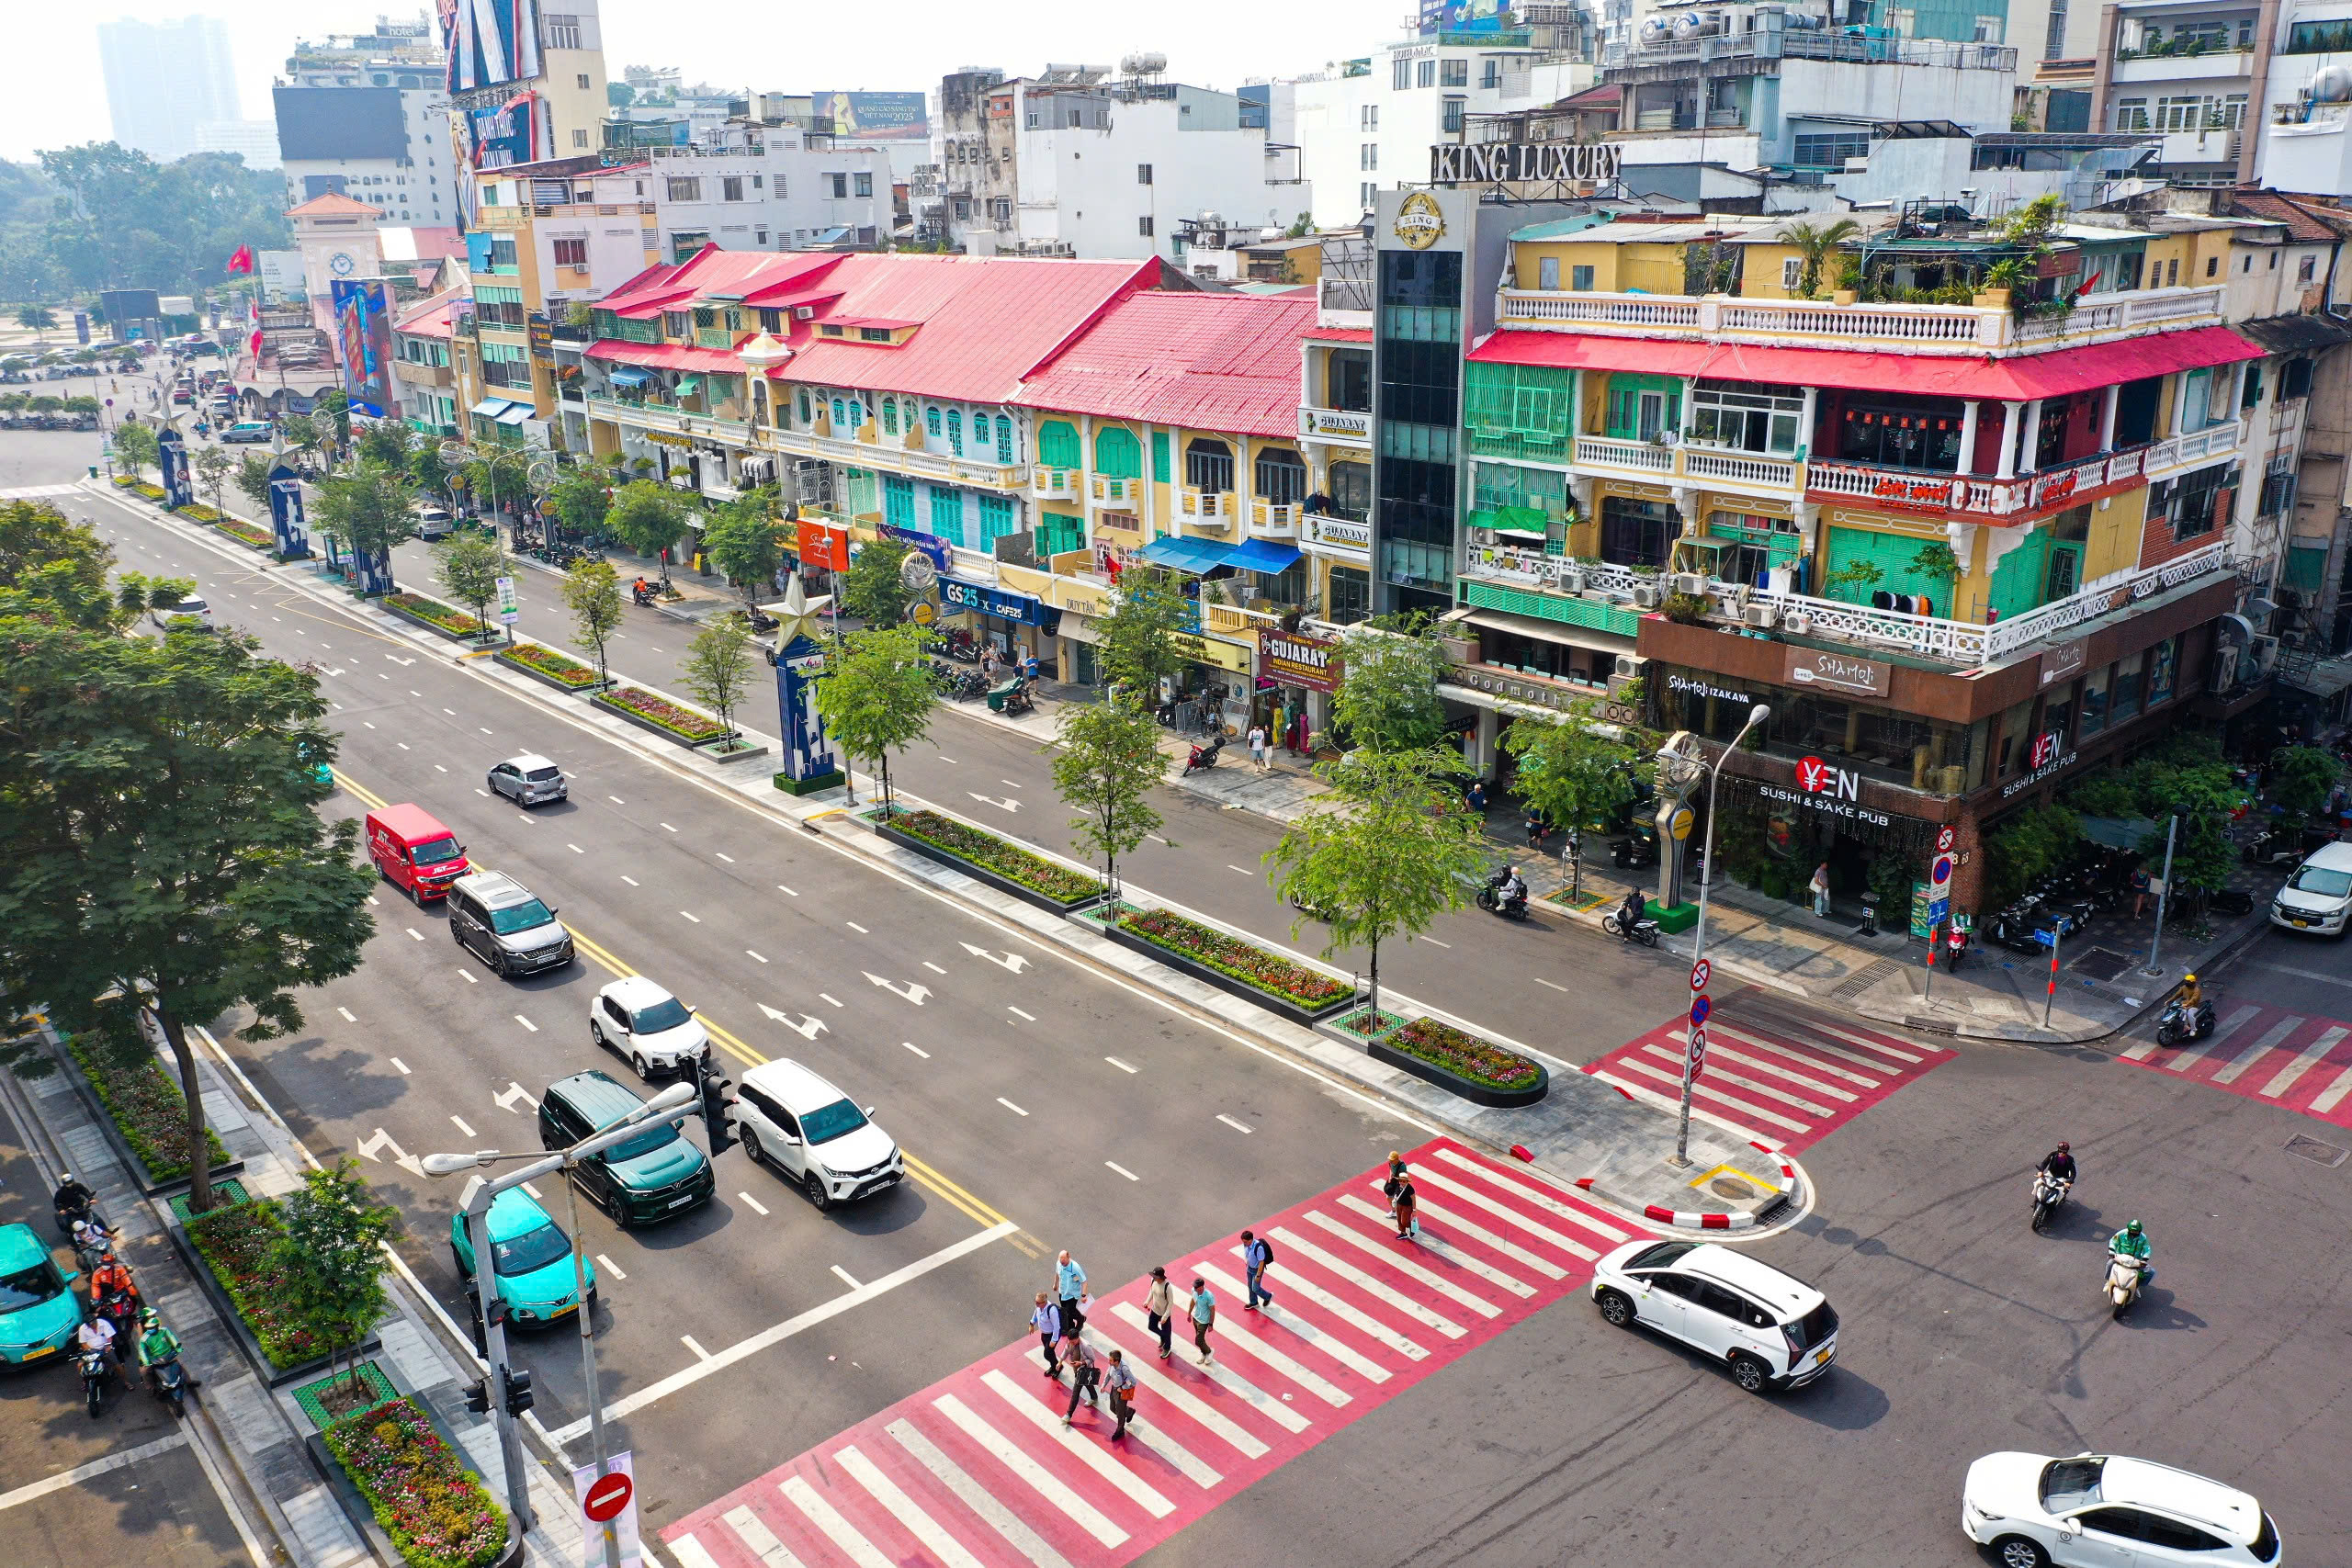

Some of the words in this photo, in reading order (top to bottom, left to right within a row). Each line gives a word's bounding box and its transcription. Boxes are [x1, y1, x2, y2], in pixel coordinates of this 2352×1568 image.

[390, 27, 415, 37] hotel
[893, 112, 914, 121] 2025
[1436, 144, 1510, 182] KING
[1518, 144, 1624, 180] LUXURY
[1404, 217, 1432, 225] KING
[1319, 417, 1364, 430] GUJARAT
[1323, 525, 1368, 540] GUJARAT
[946, 583, 978, 607] GS25
[996, 604, 1022, 618] CAFE25
[1067, 599, 1081, 611] DUY
[1081, 601, 1096, 614] TÂN
[1202, 653, 1223, 666] House
[1271, 639, 1327, 668] GUJARAT
[1272, 658, 1290, 669] INDIAN
[1291, 661, 1327, 676] RESTAURANT
[1710, 689, 1748, 704] IZAKAYA
[2004, 777, 2029, 798] SUSHI
[2030, 773, 2034, 784] &
[2036, 761, 2058, 781] SAKE
[2059, 752, 2076, 768] PUB
[1760, 786, 1801, 804] SUSHI
[1804, 797, 1812, 807] &
[1815, 799, 1854, 818] SAKE
[1859, 812, 1889, 827] PUB
[1962, 852, 1969, 865] 63
[432, 865, 447, 874] J&T
